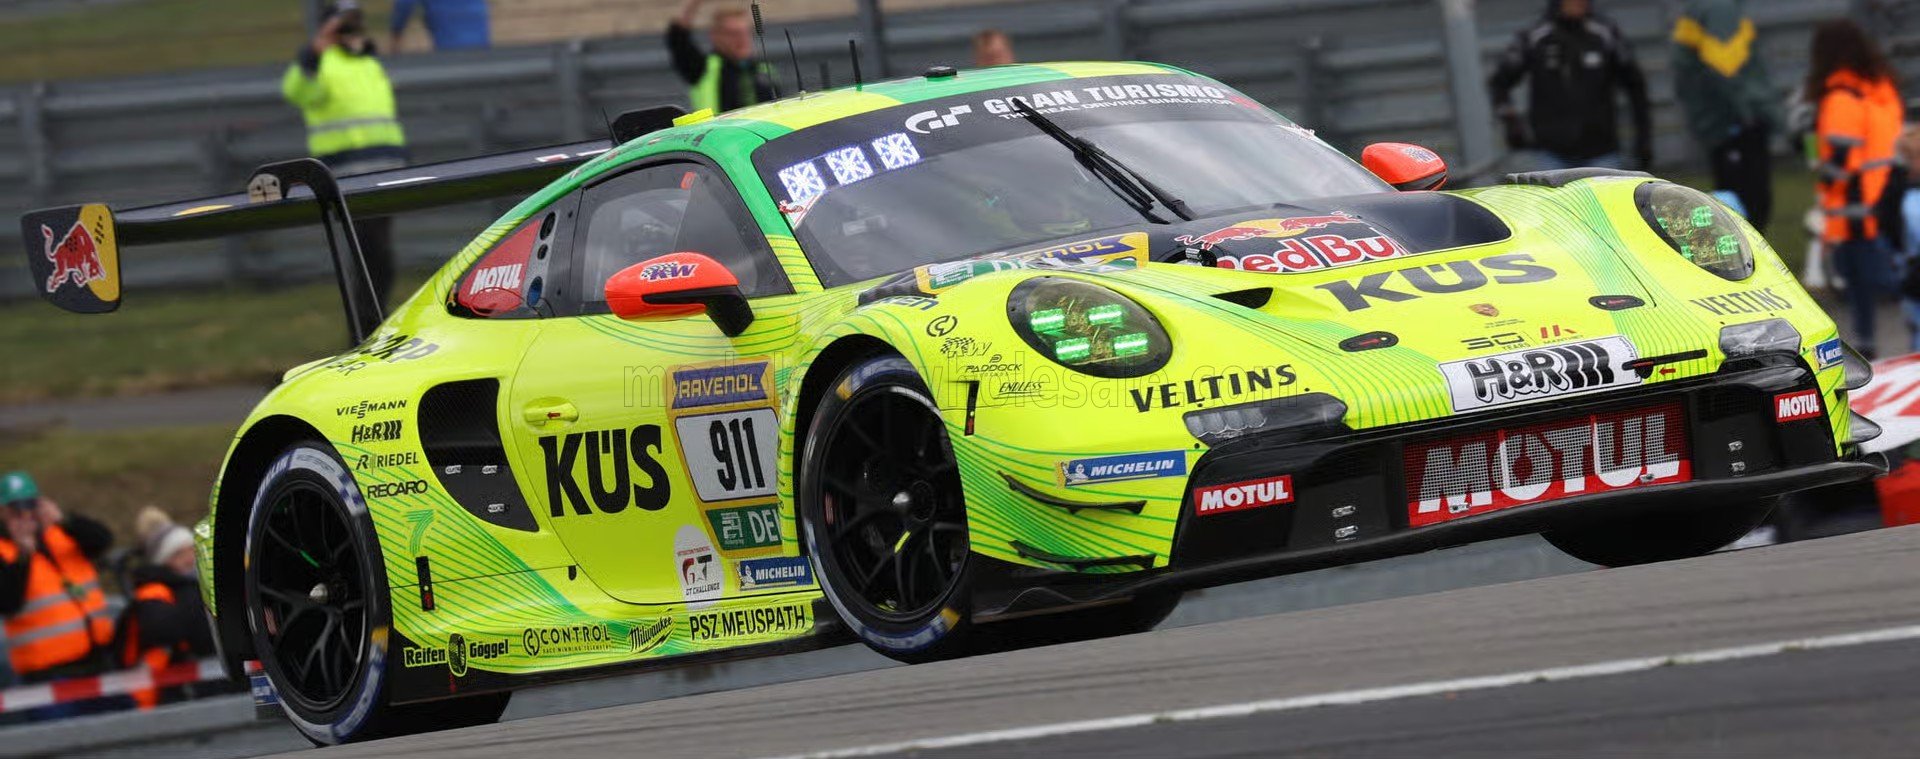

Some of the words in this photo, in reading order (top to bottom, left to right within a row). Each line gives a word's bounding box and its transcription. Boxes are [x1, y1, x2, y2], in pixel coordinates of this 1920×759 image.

[983, 89, 1080, 114] GRAN
[1082, 84, 1226, 101] TURISMO
[1081, 99, 1147, 109] DRIVING
[1149, 97, 1239, 106] SIMULATOR
[469, 263, 523, 296] MOTUL
[1314, 254, 1557, 312] KÜS
[1688, 287, 1793, 316] VELTINS
[1461, 332, 1525, 350] 30
[1502, 342, 1532, 352] YEARS
[965, 363, 1023, 374] PADDOCK
[1466, 349, 1568, 404] H&R
[679, 373, 759, 399] RAVENOL
[999, 381, 1043, 394] ENDLESS
[1129, 364, 1298, 414] VELTINS
[336, 400, 407, 419] VIESSMANN
[1778, 393, 1821, 419] MOTUL
[377, 451, 420, 469] RIEDEL
[709, 417, 766, 492] 911
[1417, 412, 1680, 514] MOTUL
[538, 424, 671, 518] KÜS
[1090, 460, 1175, 477] MICHELIN
[367, 480, 429, 499] RECARO
[1200, 480, 1289, 512] MOTUL
[755, 565, 806, 581] MICHELIN
[540, 624, 611, 645] CONTROL
[630, 616, 673, 652] Milwaukee
[689, 613, 720, 641] PSZ
[721, 605, 806, 637] MEUSPATH
[404, 647, 446, 666] Reifen
[469, 638, 509, 660] Göggel
